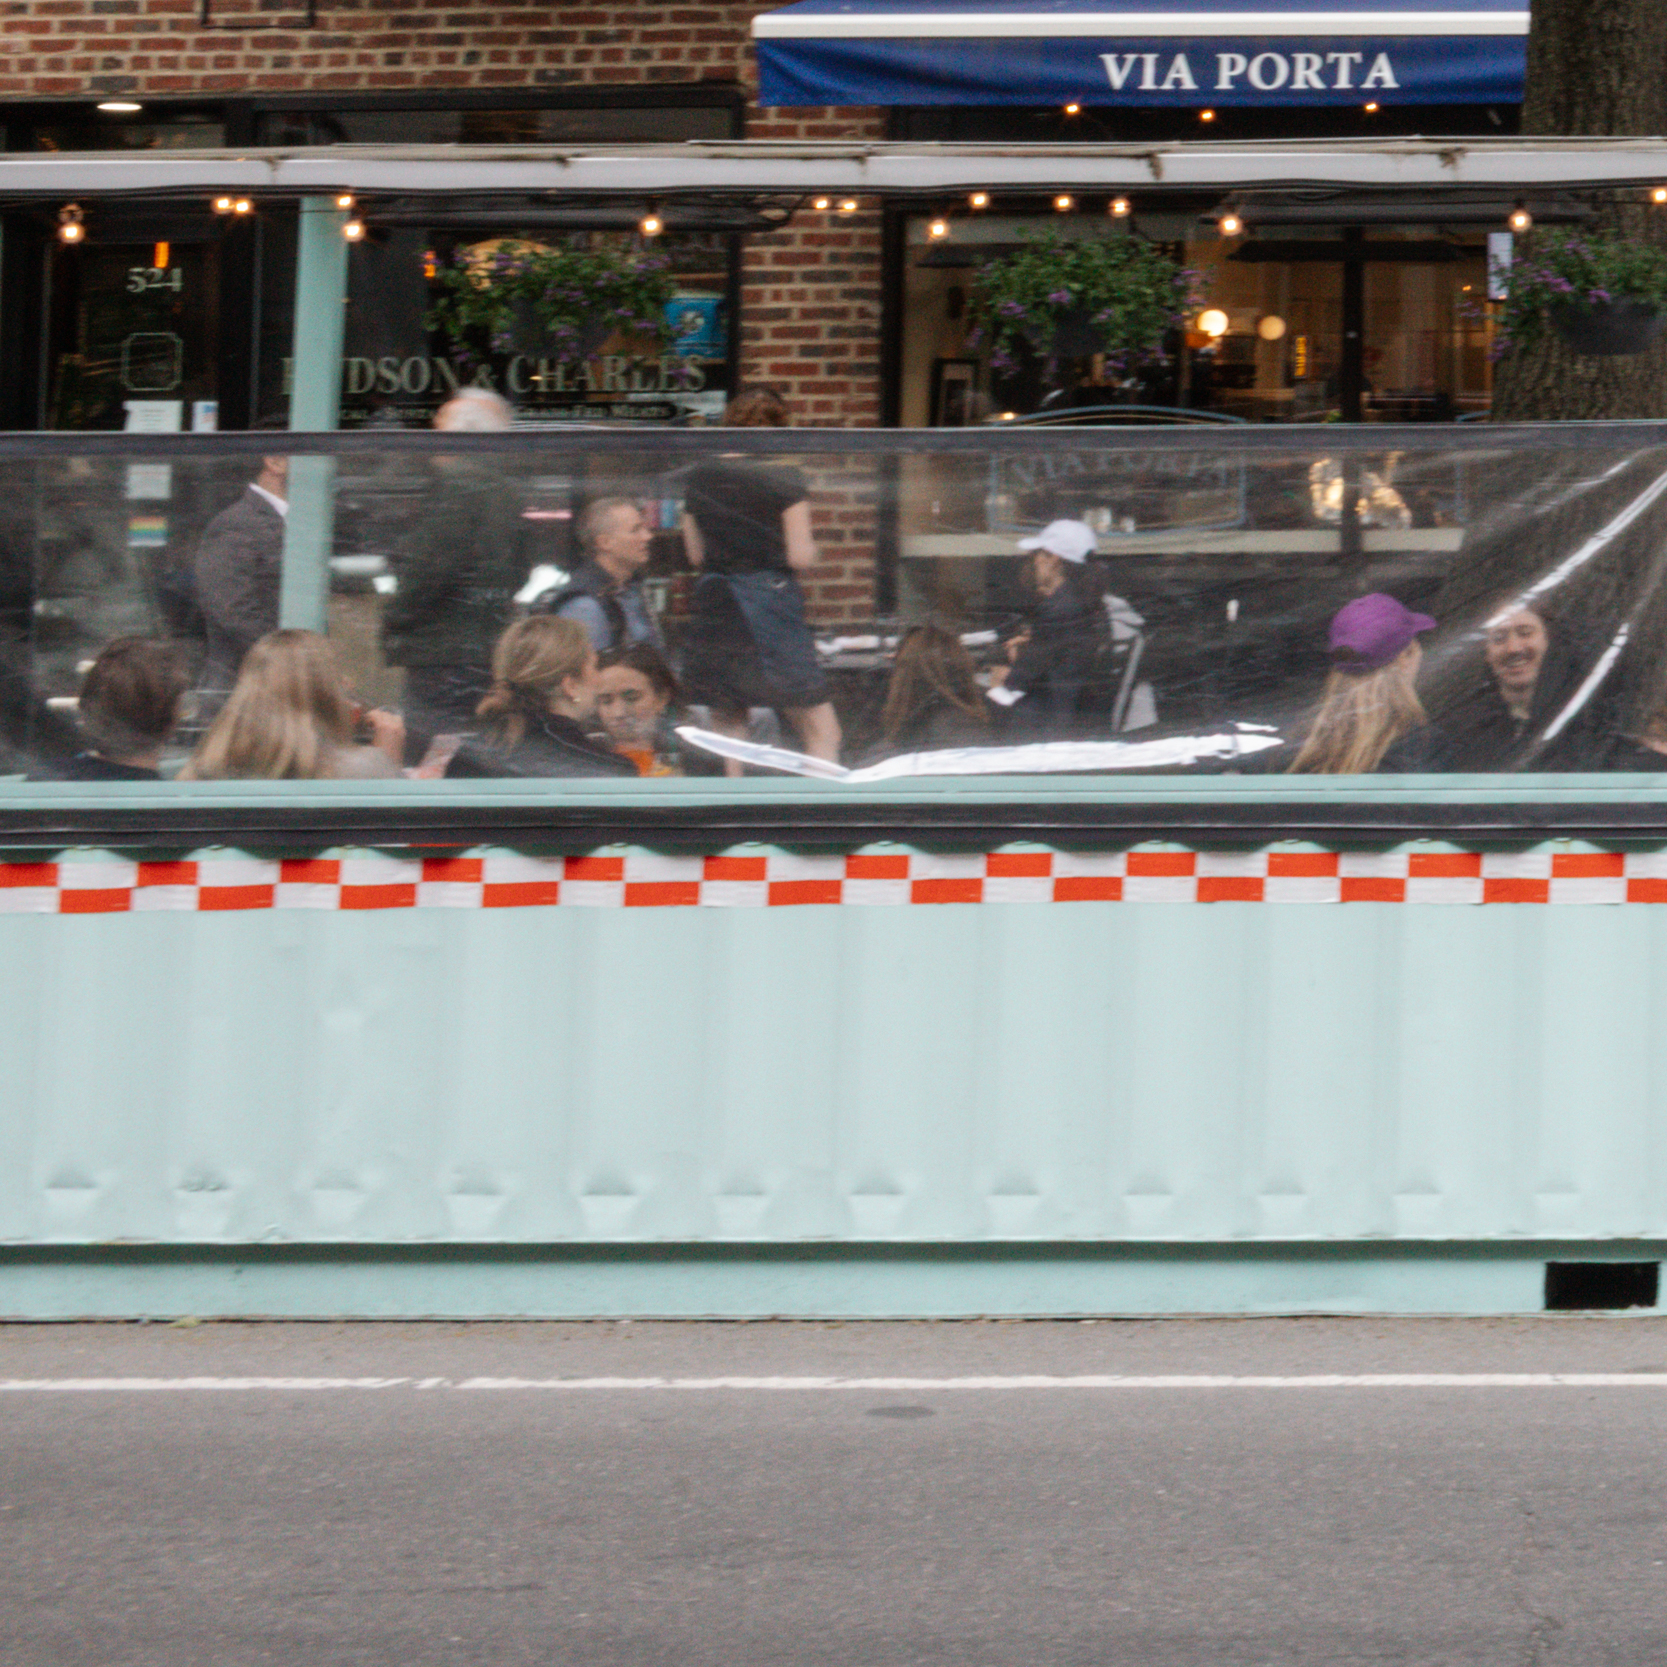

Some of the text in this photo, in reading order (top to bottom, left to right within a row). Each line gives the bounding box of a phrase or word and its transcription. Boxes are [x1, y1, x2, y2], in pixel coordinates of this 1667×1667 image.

[1098, 52, 1401, 90] VIA PORTA
[126, 267, 184, 293] 524
[281, 355, 461, 395] DSON
[508, 354, 706, 394] CHARLES
